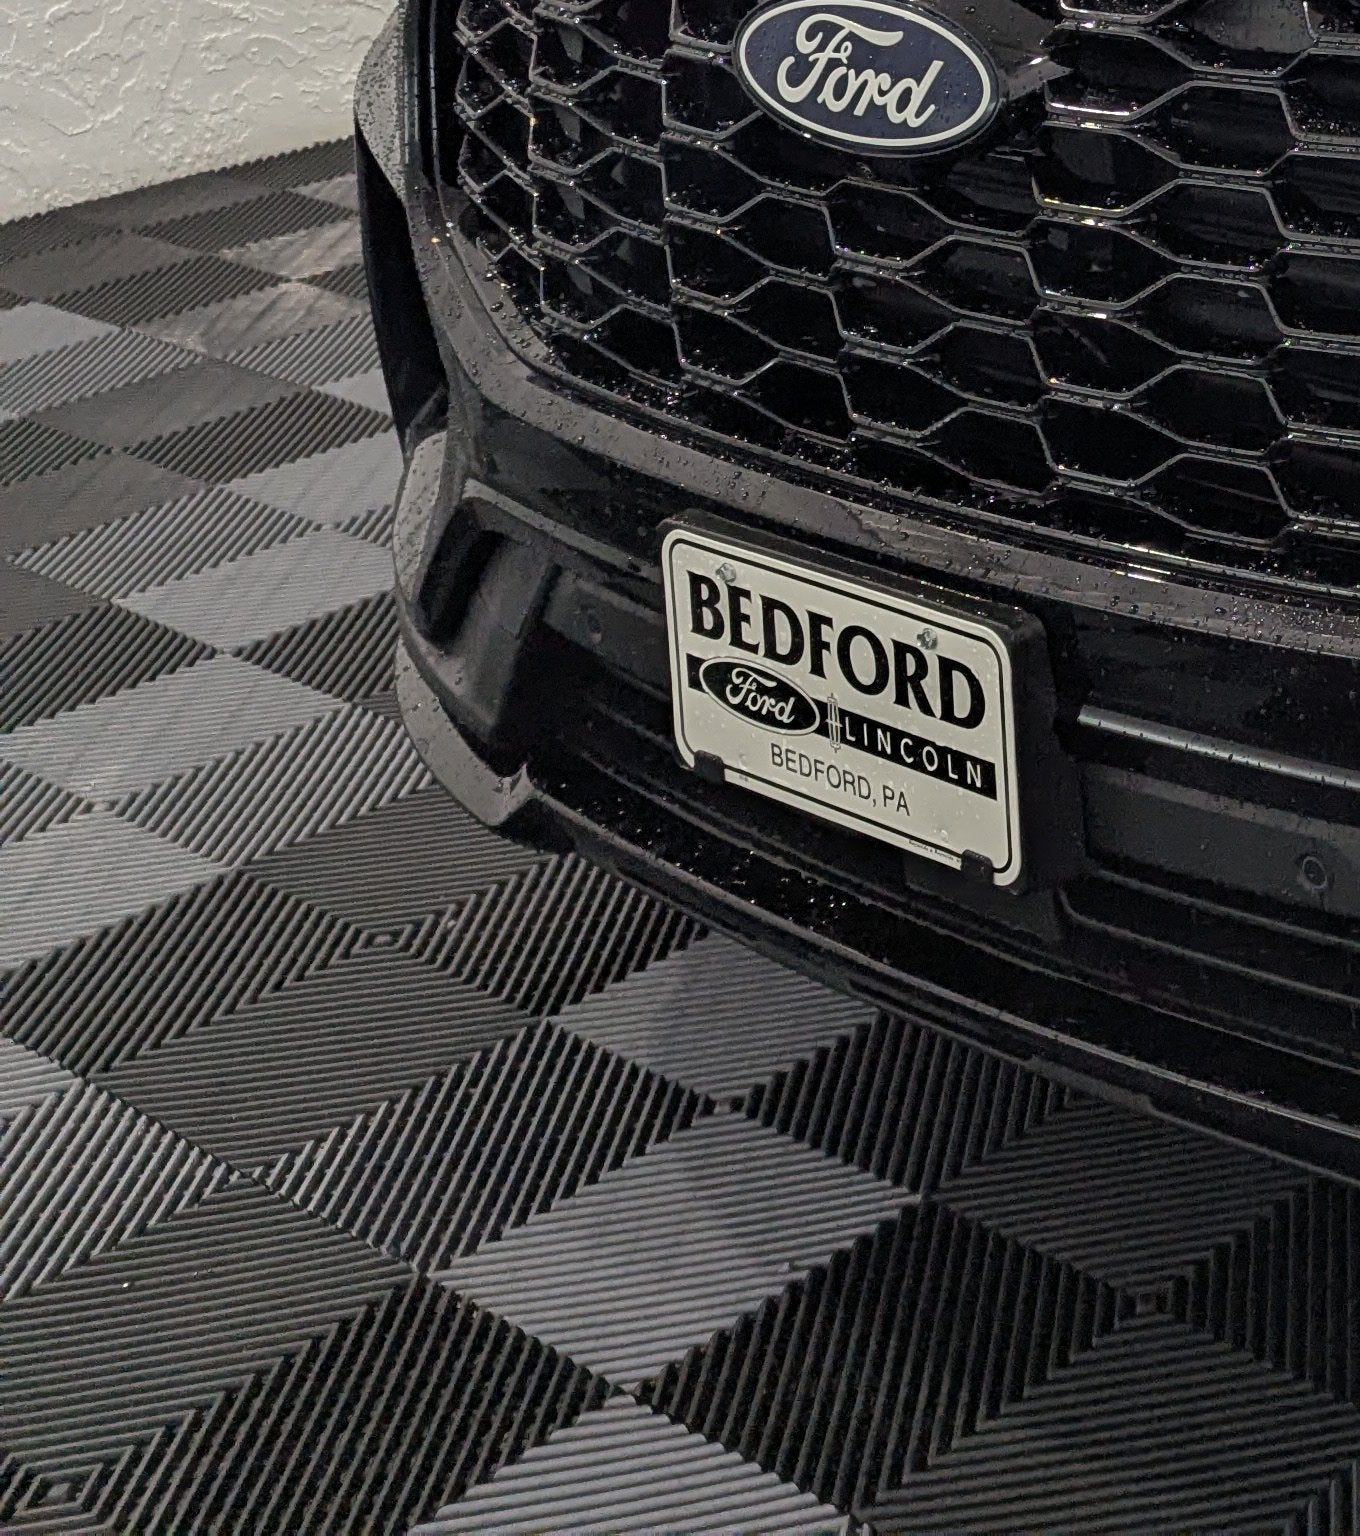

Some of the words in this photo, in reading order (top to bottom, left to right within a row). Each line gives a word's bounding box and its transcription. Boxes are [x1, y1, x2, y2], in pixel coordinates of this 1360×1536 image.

[776, 12, 944, 128] Ford
[686, 570, 986, 730] BEDFORD
[725, 667, 796, 725] Ford
[770, 742, 878, 808] BEDFORD,
[882, 785, 911, 817] PA
[844, 723, 983, 789] LINCOLN
